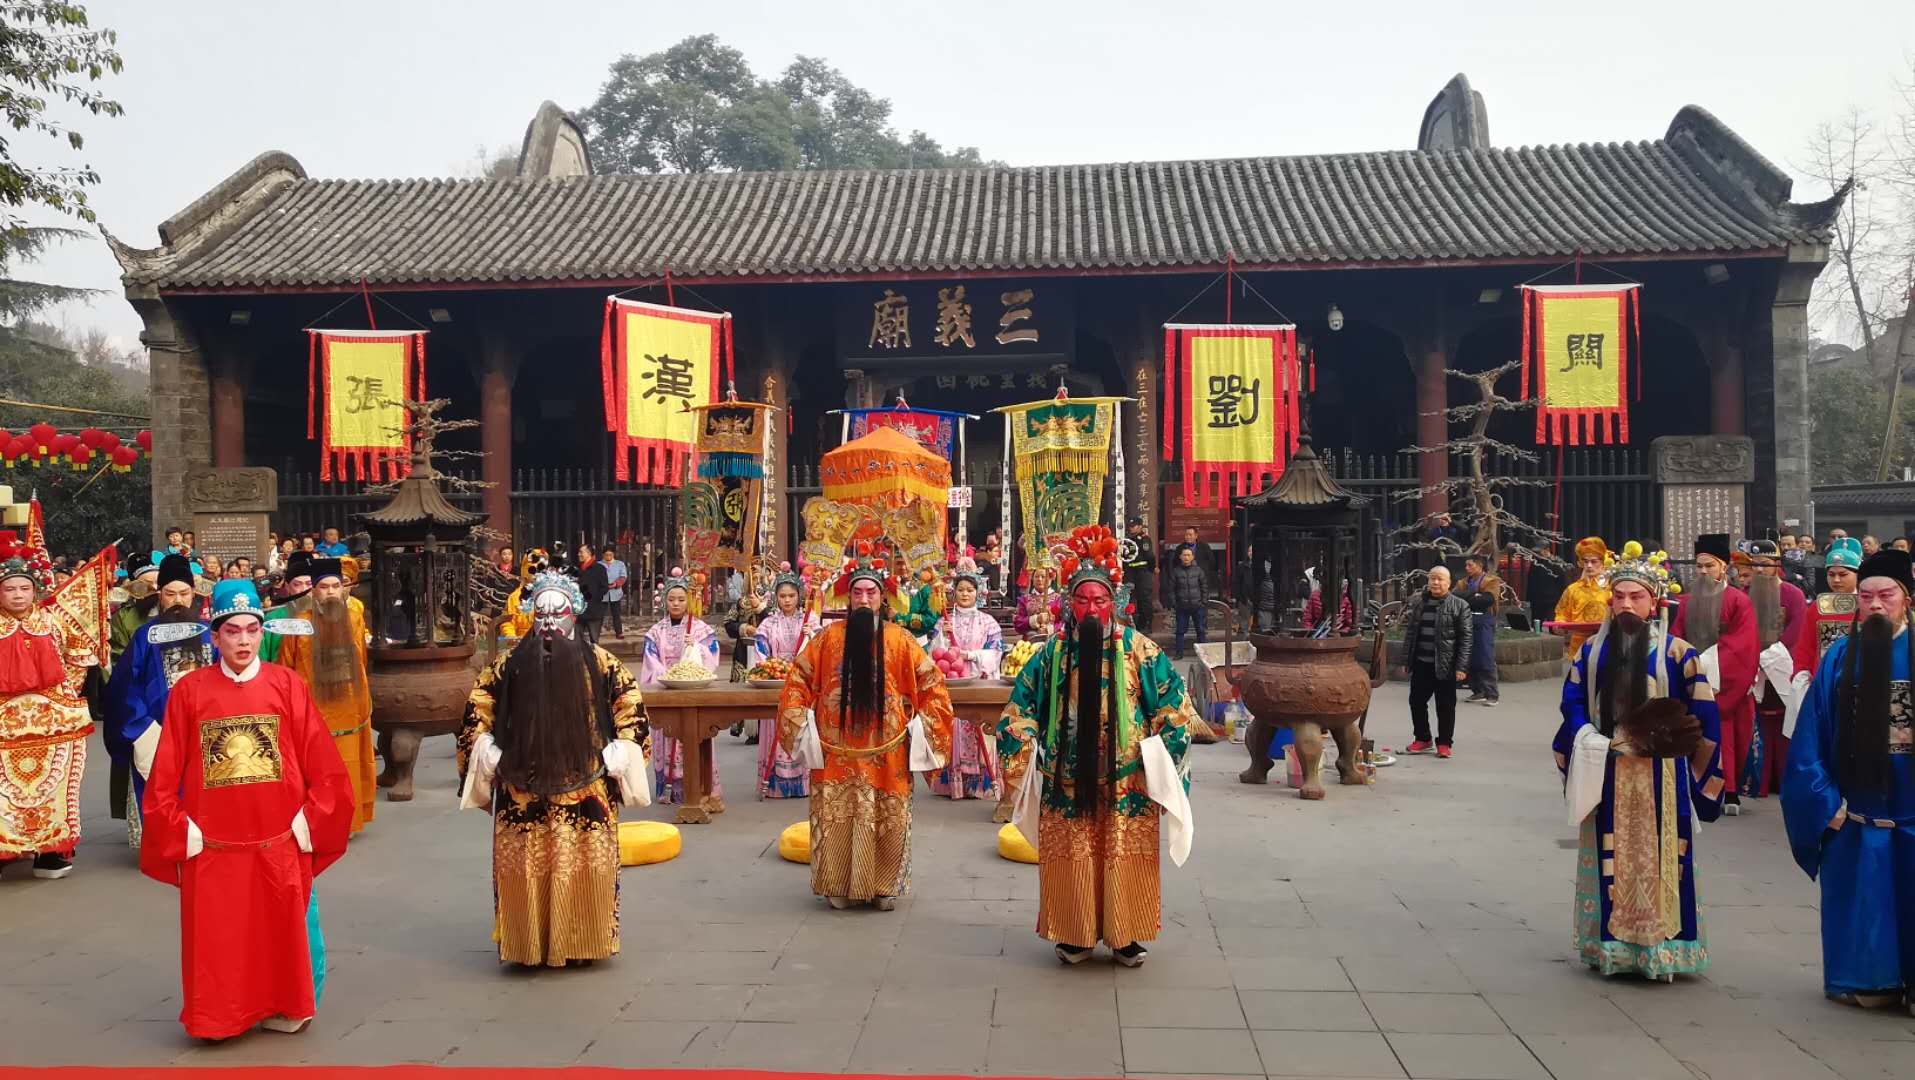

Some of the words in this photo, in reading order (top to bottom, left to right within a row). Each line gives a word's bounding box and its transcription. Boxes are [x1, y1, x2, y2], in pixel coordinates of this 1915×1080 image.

[1560, 333, 1605, 372] 關
[345, 375, 389, 414] 張
[641, 353, 696, 412] 漢
[1207, 374, 1260, 428] 劉
